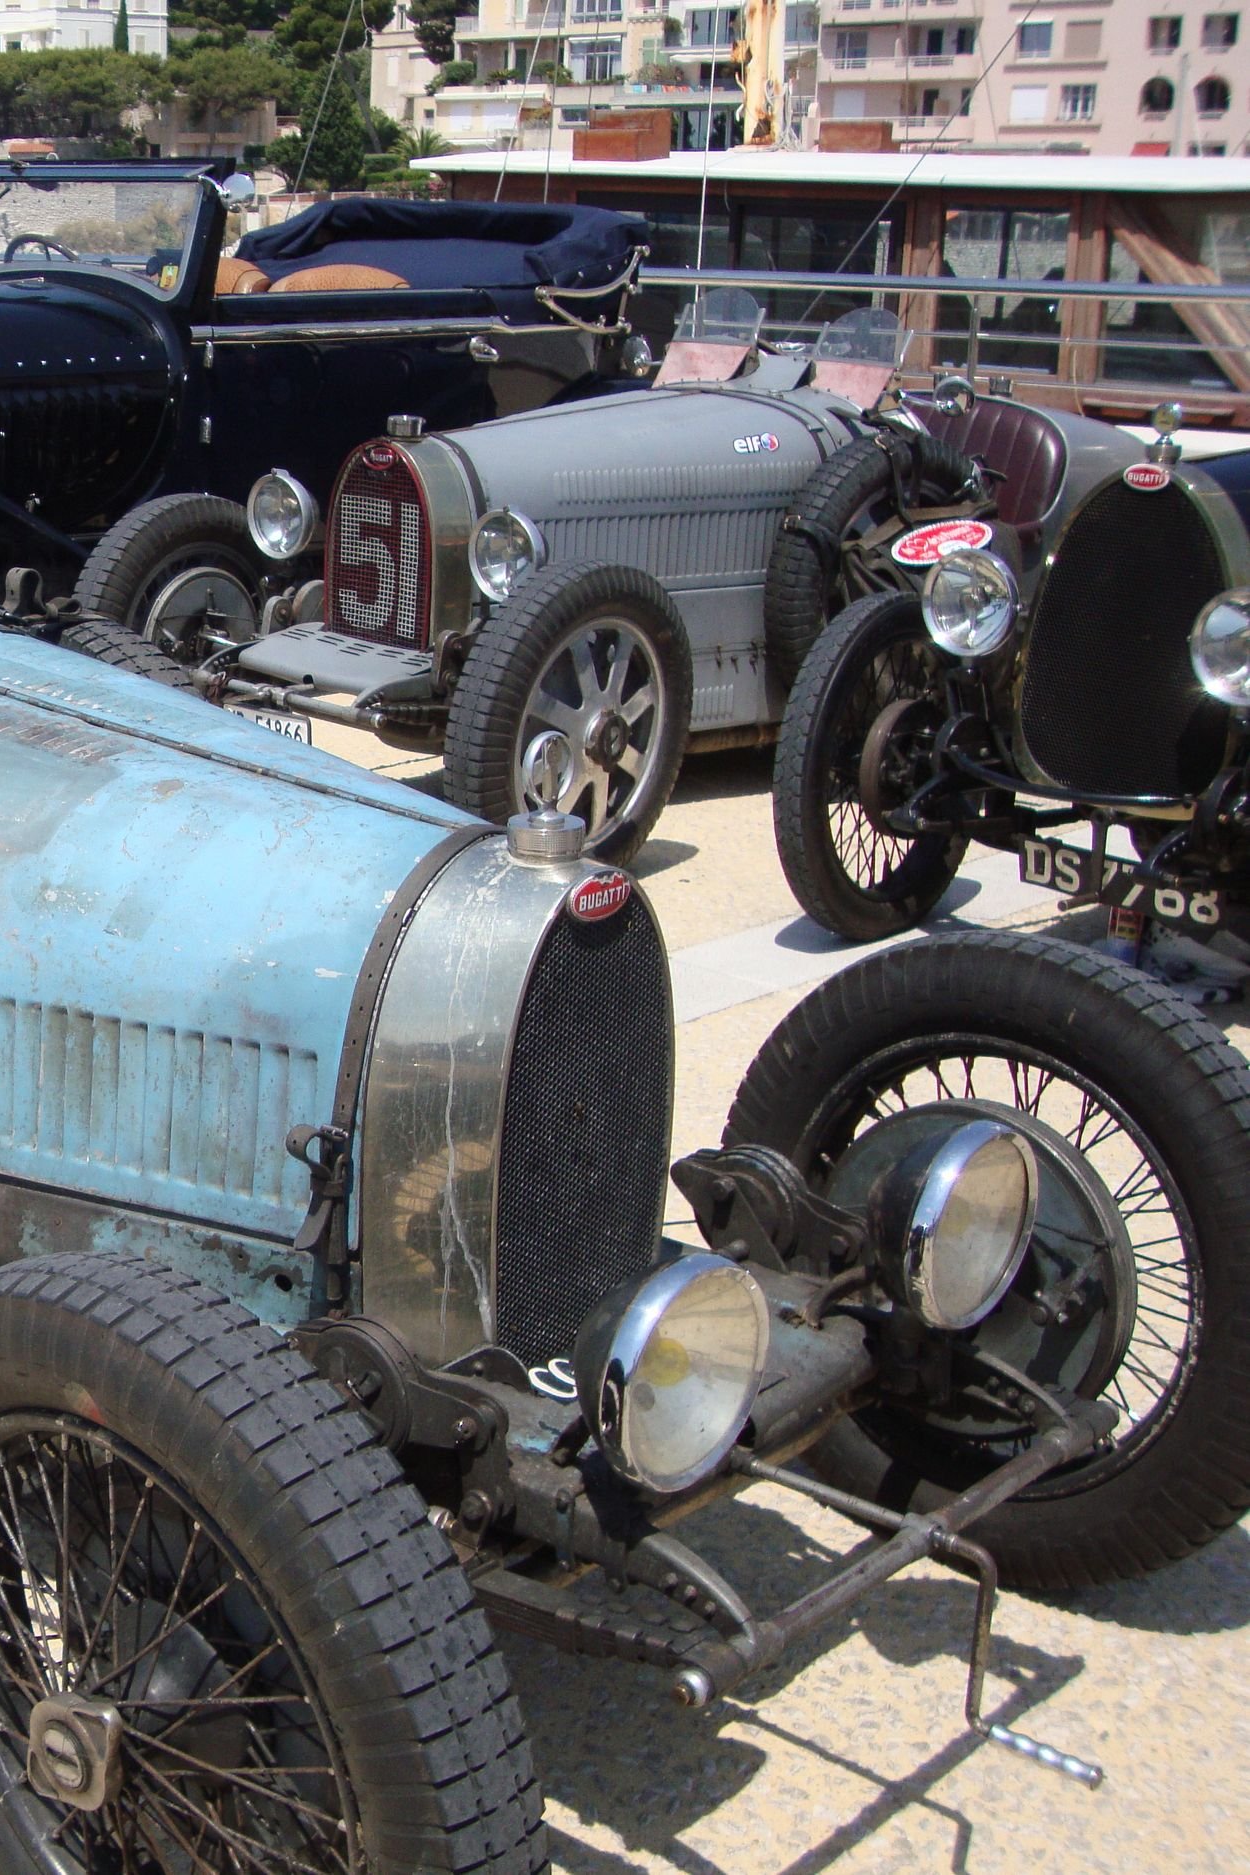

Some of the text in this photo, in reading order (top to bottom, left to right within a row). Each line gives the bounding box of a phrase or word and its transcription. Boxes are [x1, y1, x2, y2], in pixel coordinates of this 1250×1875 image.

[733, 436, 761, 453] elf
[1127, 472, 1163, 484] BUGATTI
[339, 494, 419, 639] 51
[1024, 840, 1081, 892] DS
[579, 882, 626, 912] BUGATTI
